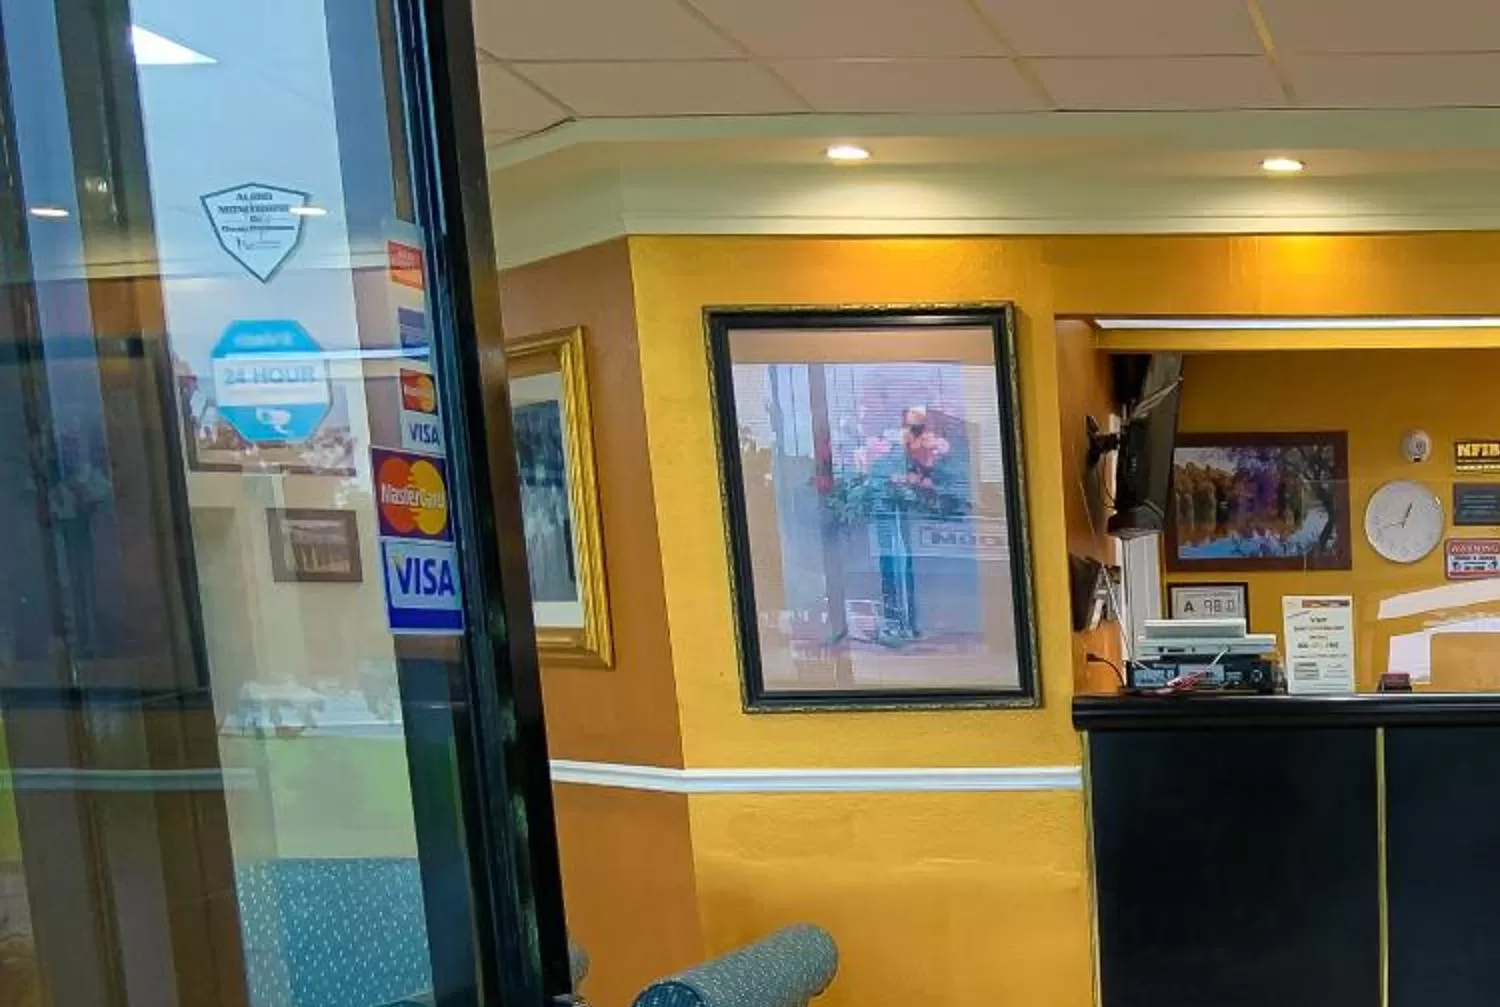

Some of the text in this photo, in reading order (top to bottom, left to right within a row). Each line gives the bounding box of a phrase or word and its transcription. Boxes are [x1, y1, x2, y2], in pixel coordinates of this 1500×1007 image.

[253, 366, 315, 383] HOUR
[409, 423, 441, 447] VISA
[1451, 544, 1500, 554] WARNING
[393, 556, 456, 597] VISA
